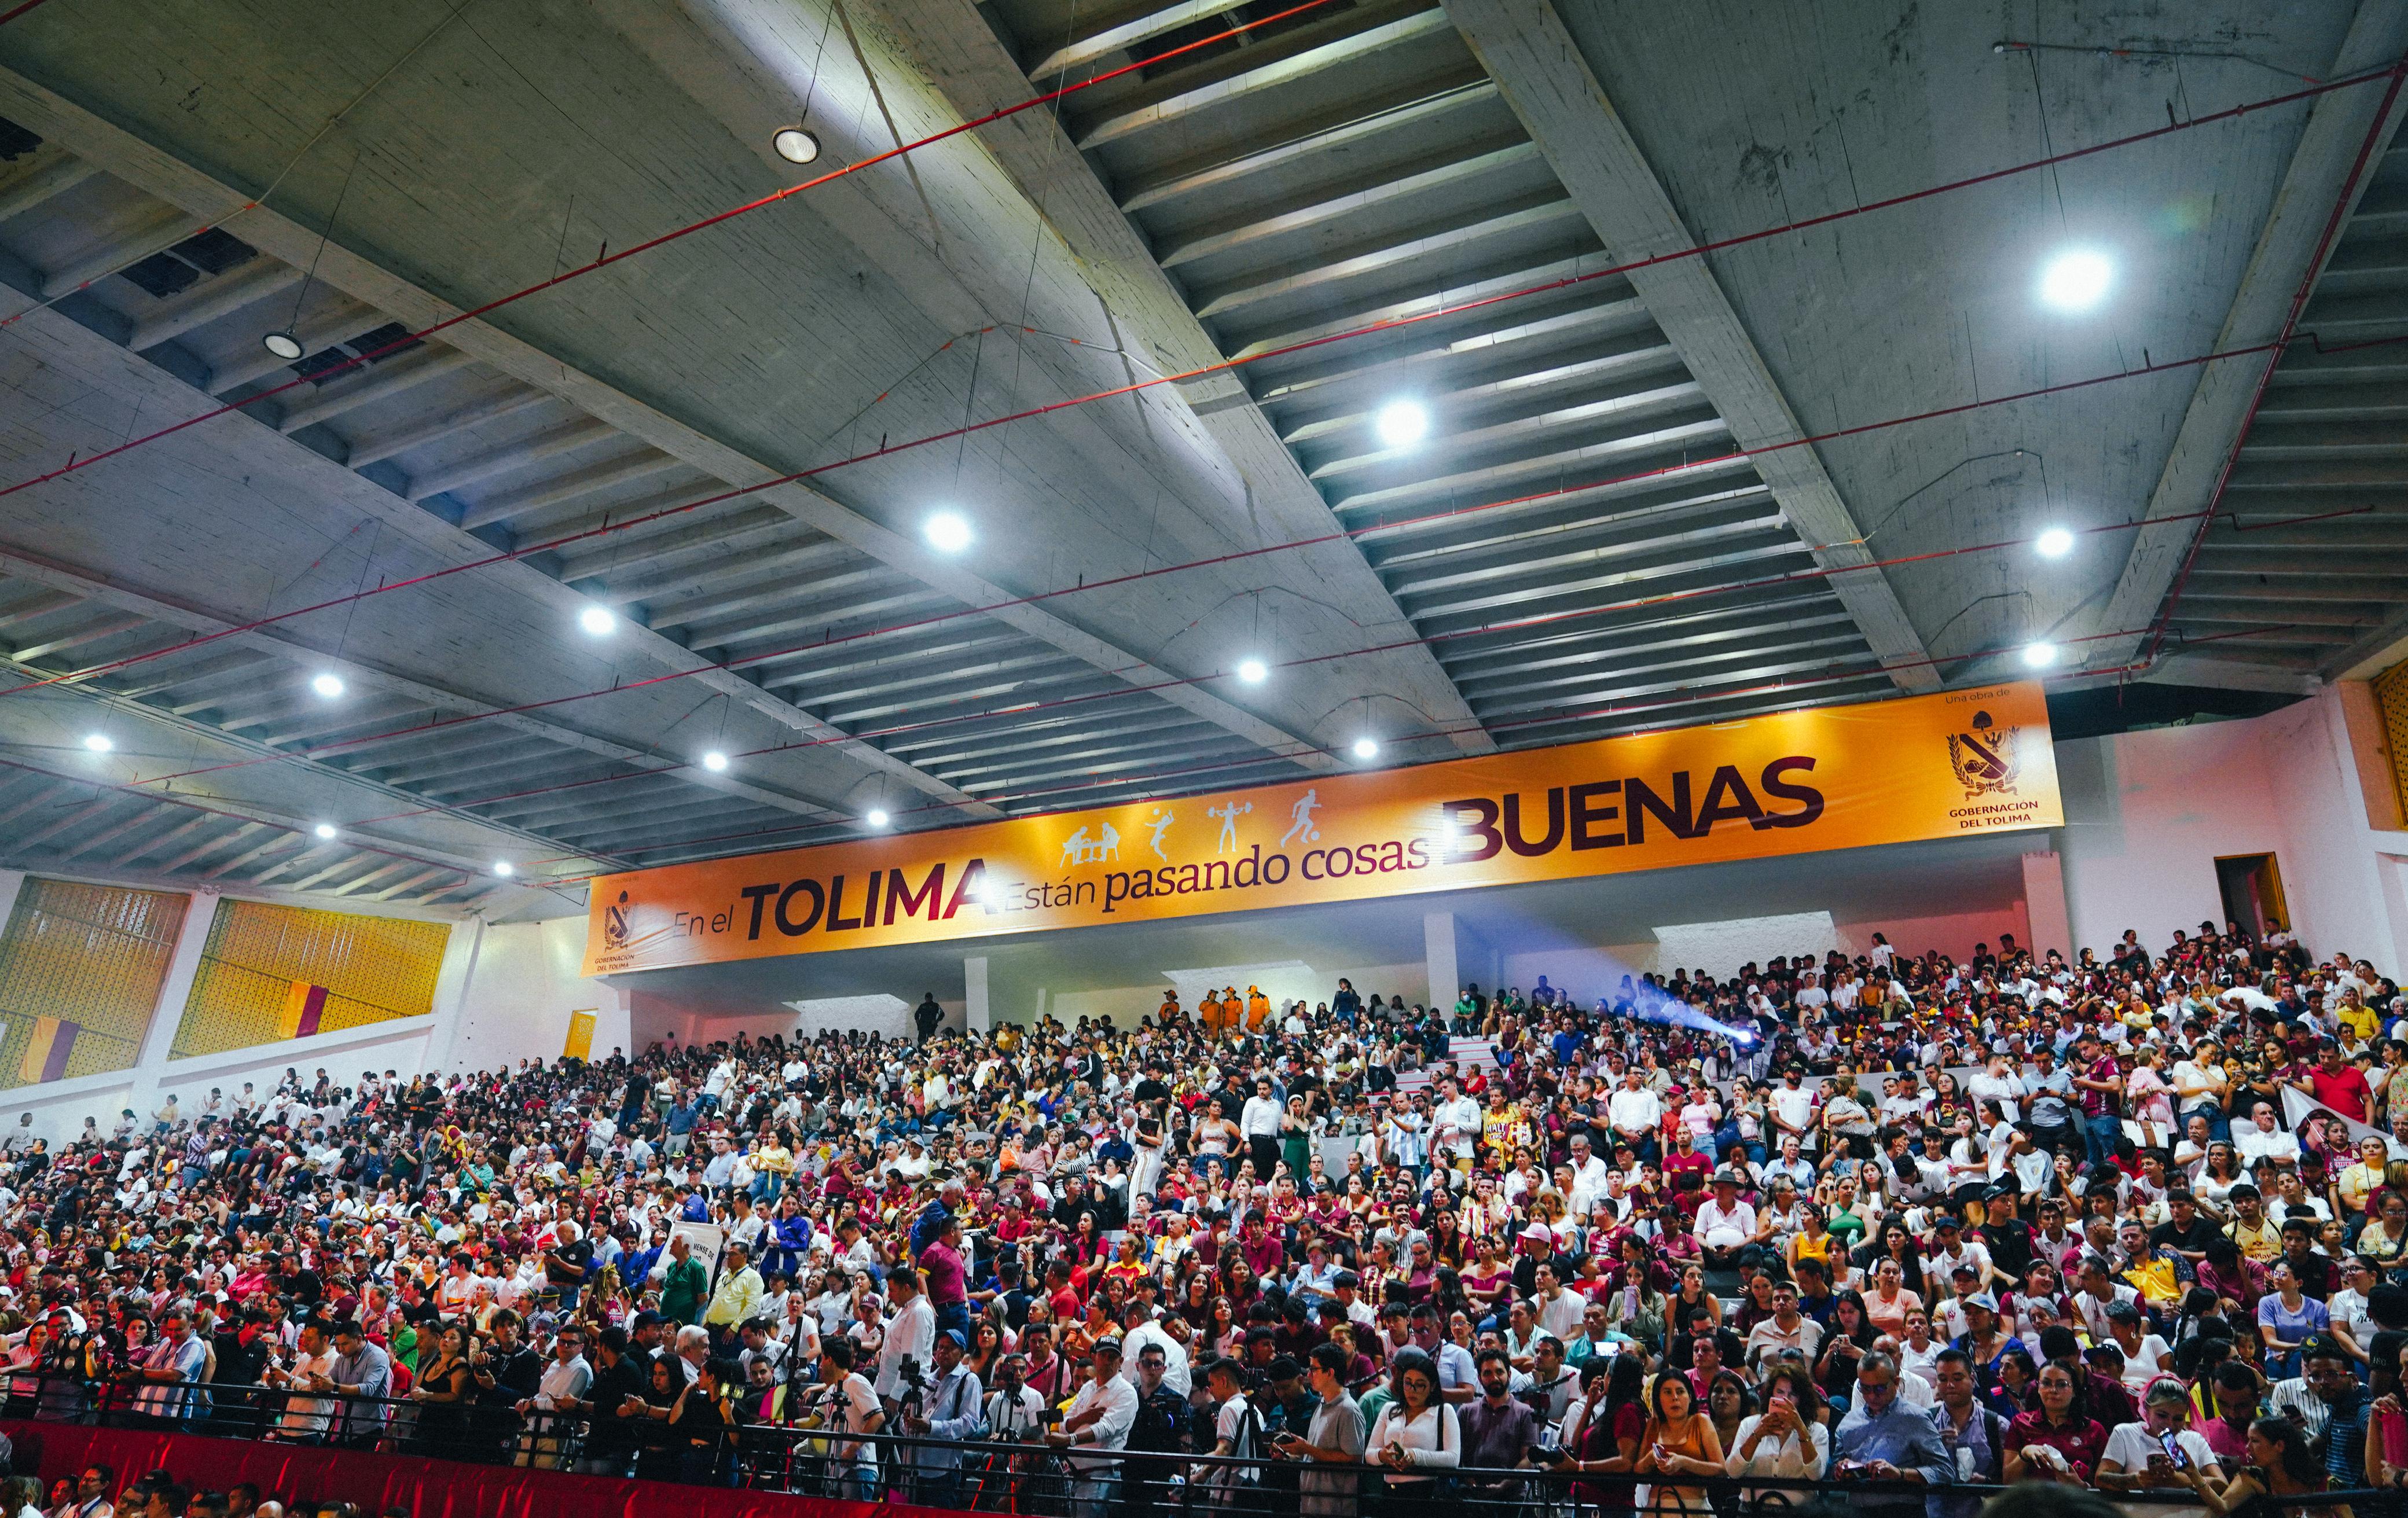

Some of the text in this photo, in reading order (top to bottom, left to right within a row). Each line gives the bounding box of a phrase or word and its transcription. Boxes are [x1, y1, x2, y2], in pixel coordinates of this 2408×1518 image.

[1946, 688, 2010, 704] Una obra de
[1950, 799, 2038, 818] GOBERNACIÓN
[1961, 814, 2031, 828] DEL TOLIMA
[673, 756, 1825, 940] En el TOLIMA Están pasando cosas BUENAS
[1486, 1123, 1506, 1133] MALT
[693, 1243, 715, 1260] MENSE DE
[1100, 1335, 1119, 1346] PRENSA
